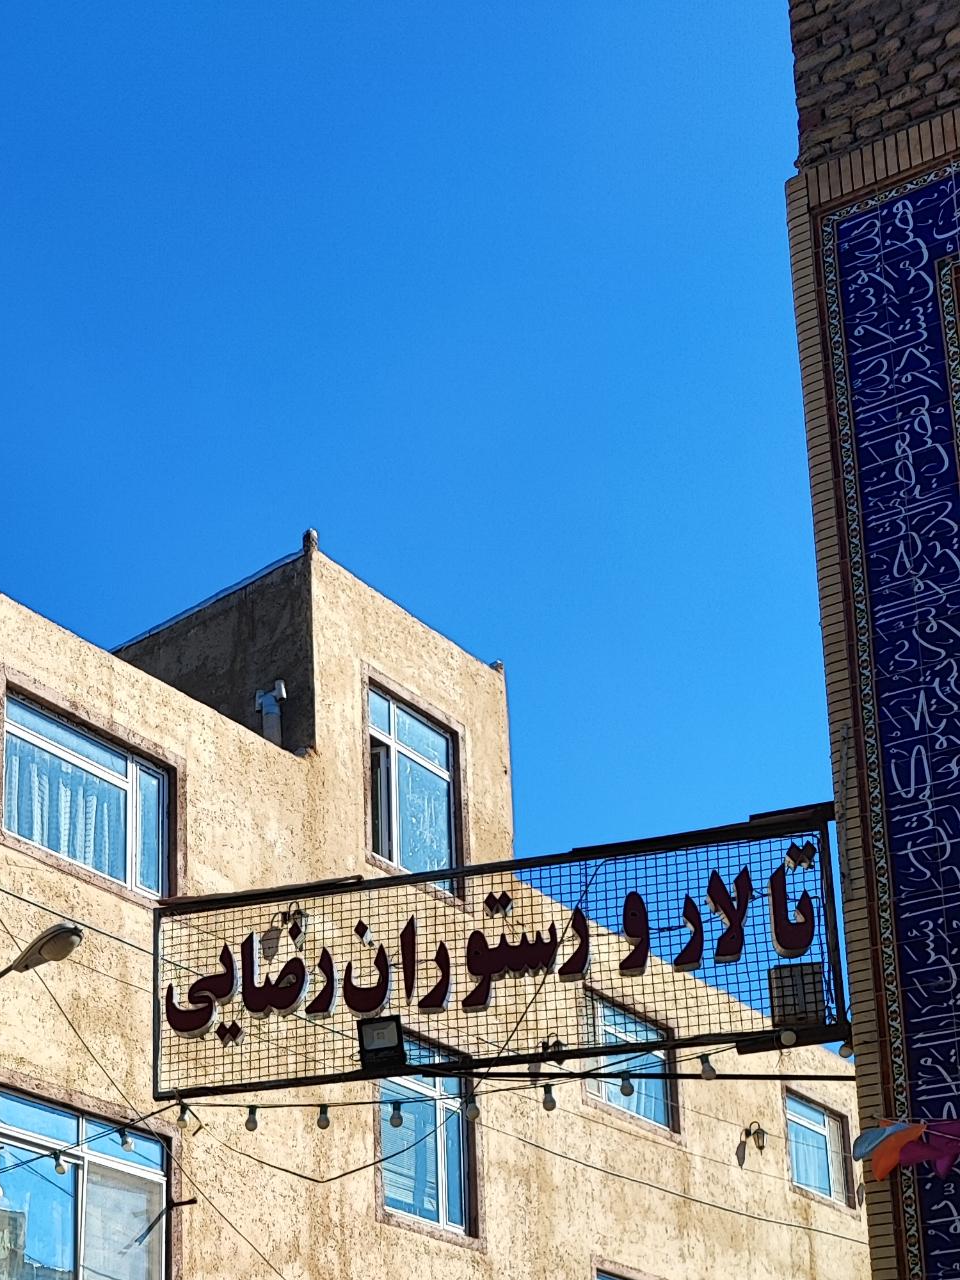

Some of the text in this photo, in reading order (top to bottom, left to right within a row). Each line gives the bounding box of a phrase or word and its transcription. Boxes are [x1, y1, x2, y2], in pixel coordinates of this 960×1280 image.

[342, 891, 591, 1017] رستوران
[673, 839, 817, 971] تالار
[164, 919, 337, 1046] رضایی
